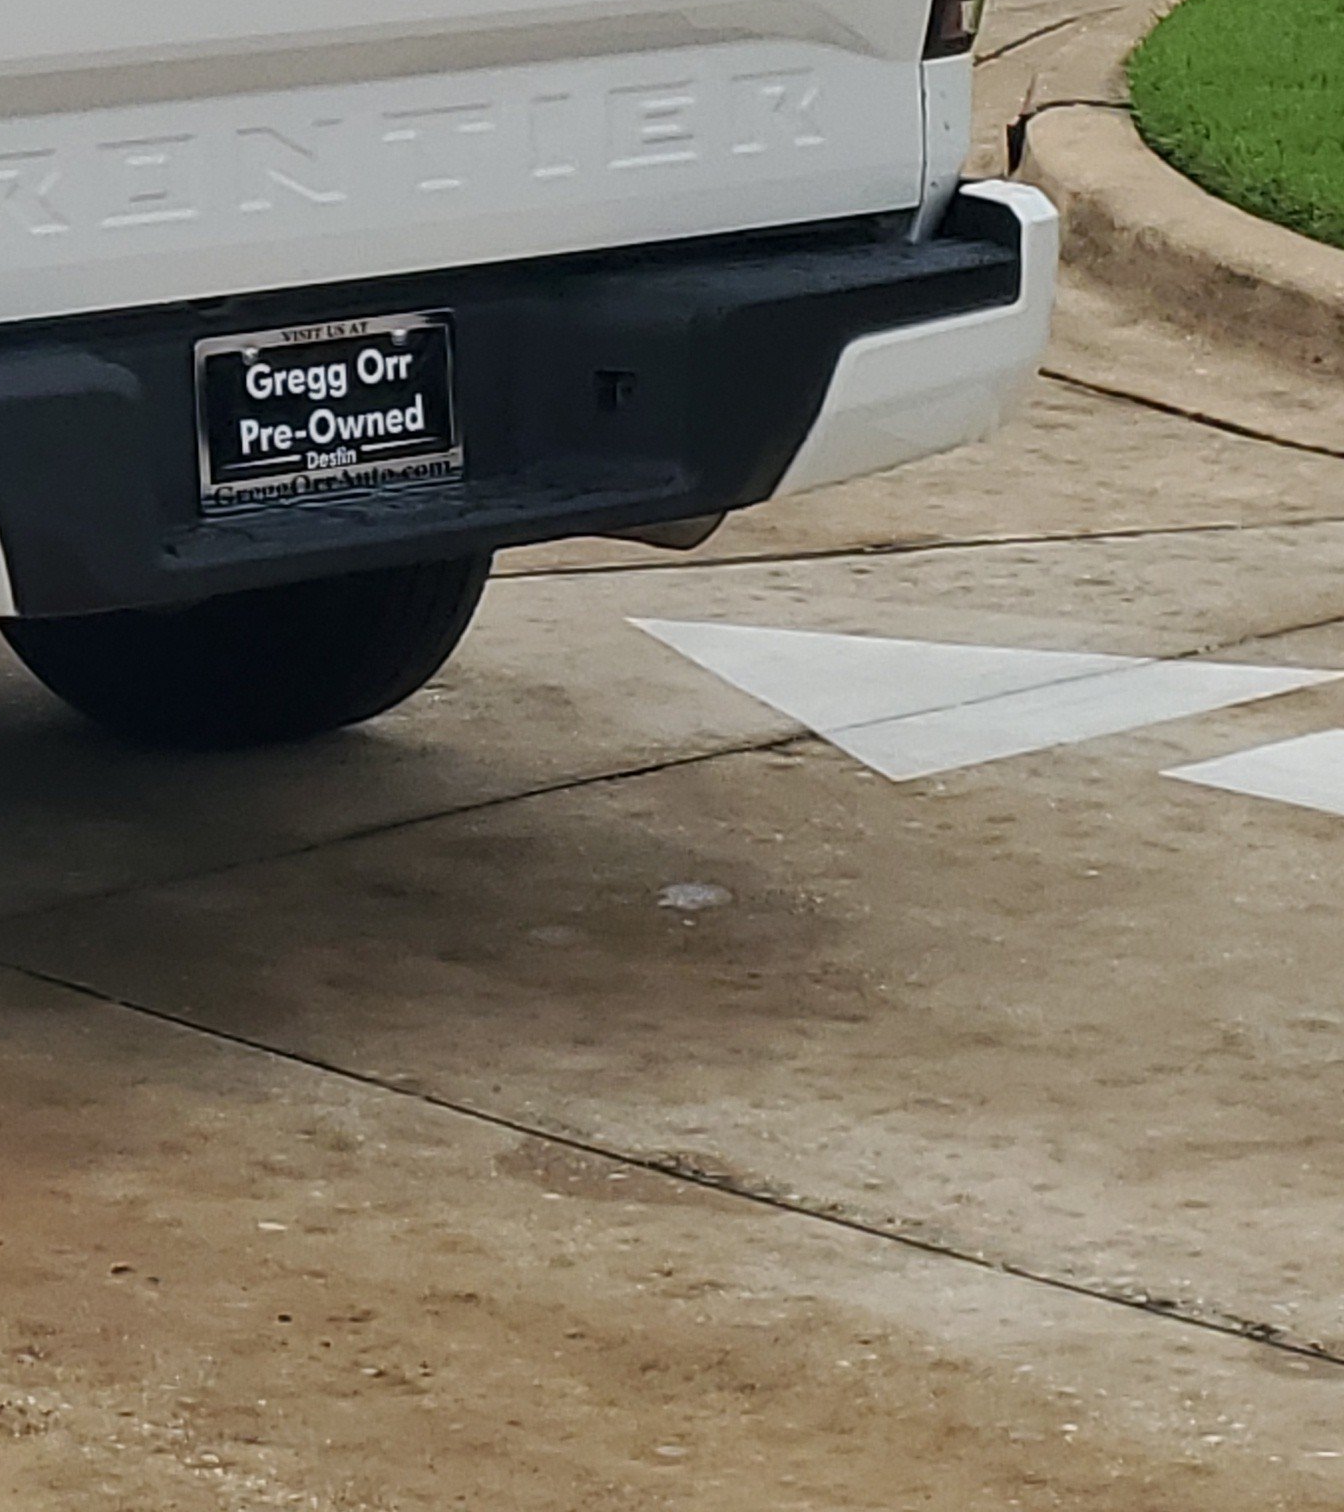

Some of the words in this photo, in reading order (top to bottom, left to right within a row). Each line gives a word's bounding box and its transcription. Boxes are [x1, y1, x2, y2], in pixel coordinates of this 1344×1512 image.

[281, 327, 322, 342] VISIT
[326, 323, 345, 338] US
[350, 320, 368, 334] AT
[245, 362, 348, 401] Gregg
[356, 348, 413, 385] Orr
[239, 392, 426, 456] Pre-Owned
[306, 446, 358, 470] Destin
